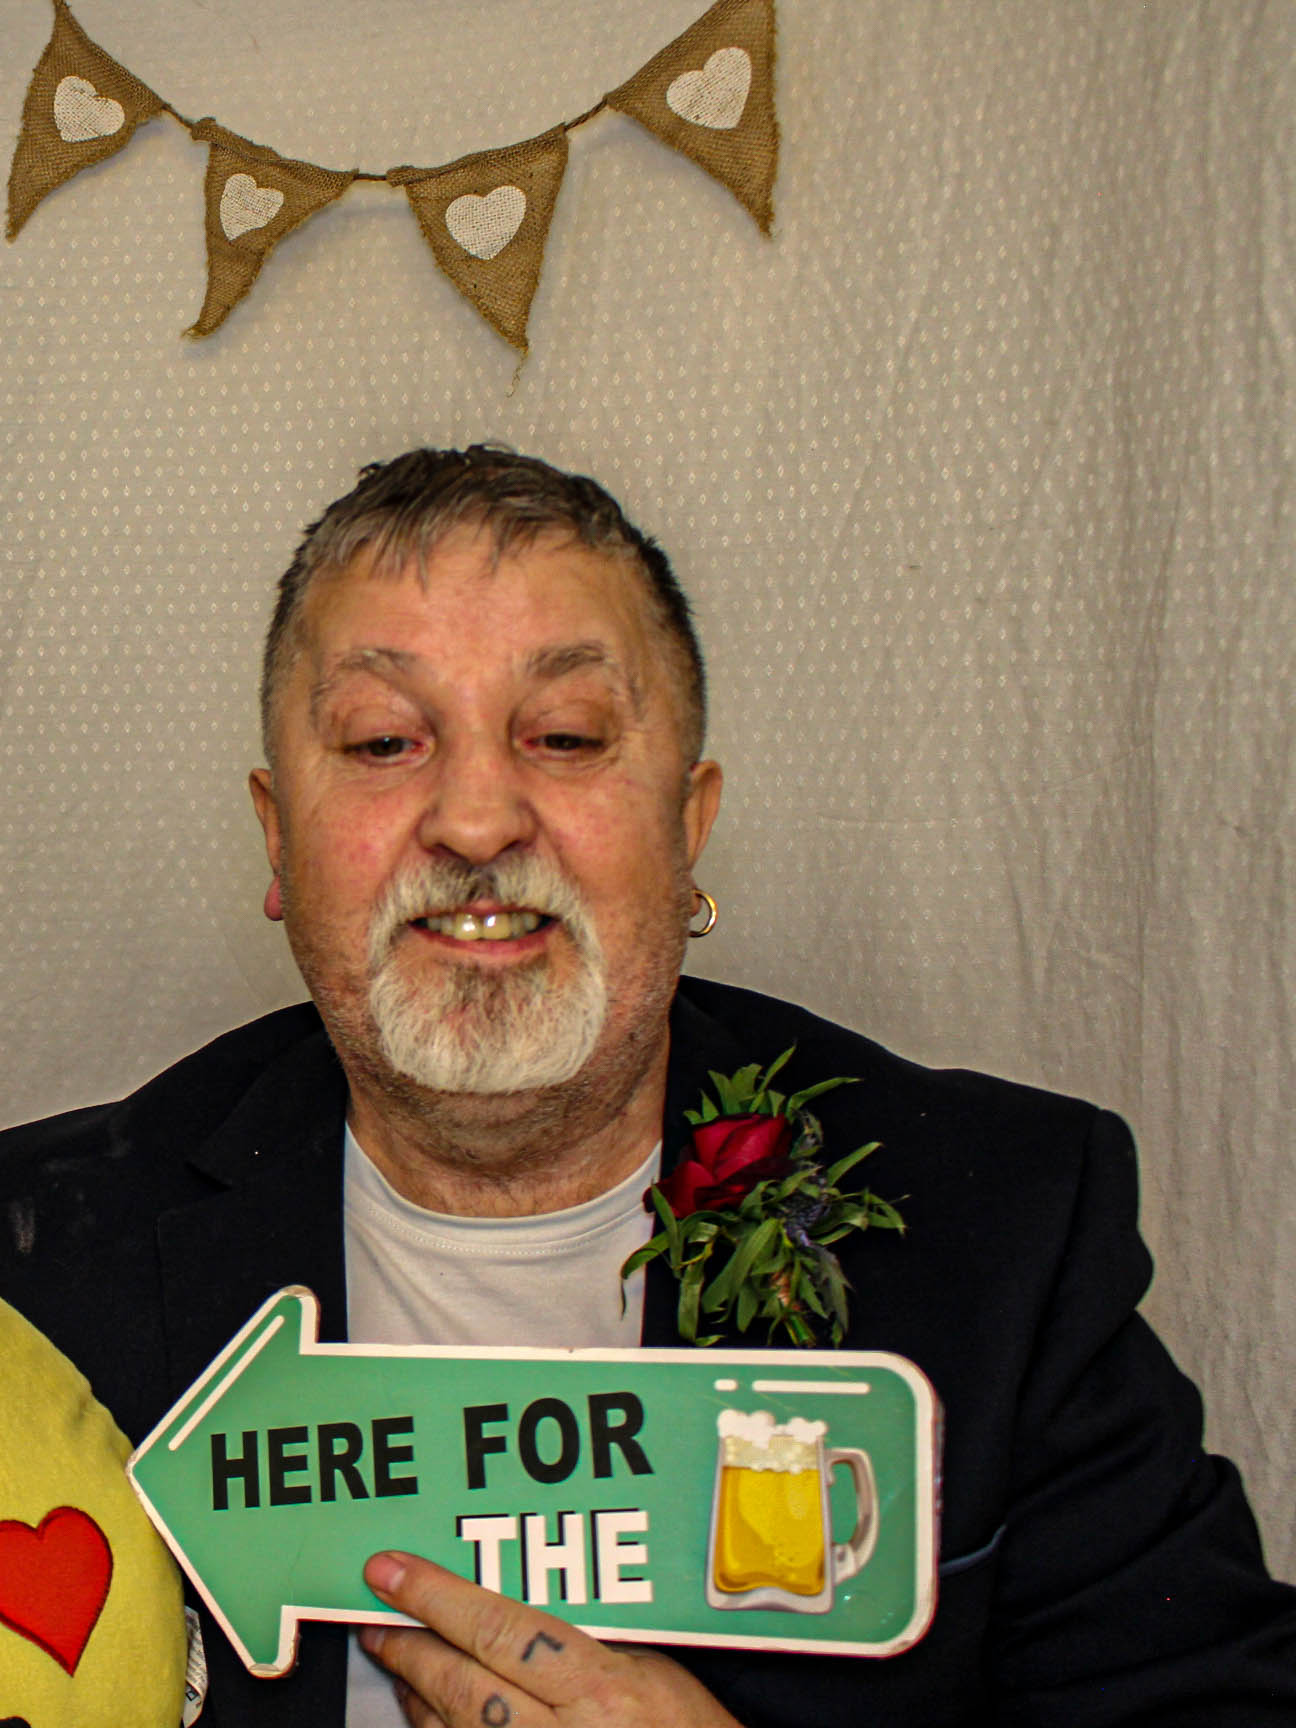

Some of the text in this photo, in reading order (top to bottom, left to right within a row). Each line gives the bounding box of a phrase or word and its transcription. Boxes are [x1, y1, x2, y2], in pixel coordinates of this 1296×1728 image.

[211, 1391, 654, 1511] HERE FOR
[456, 1508, 653, 1605] THE
